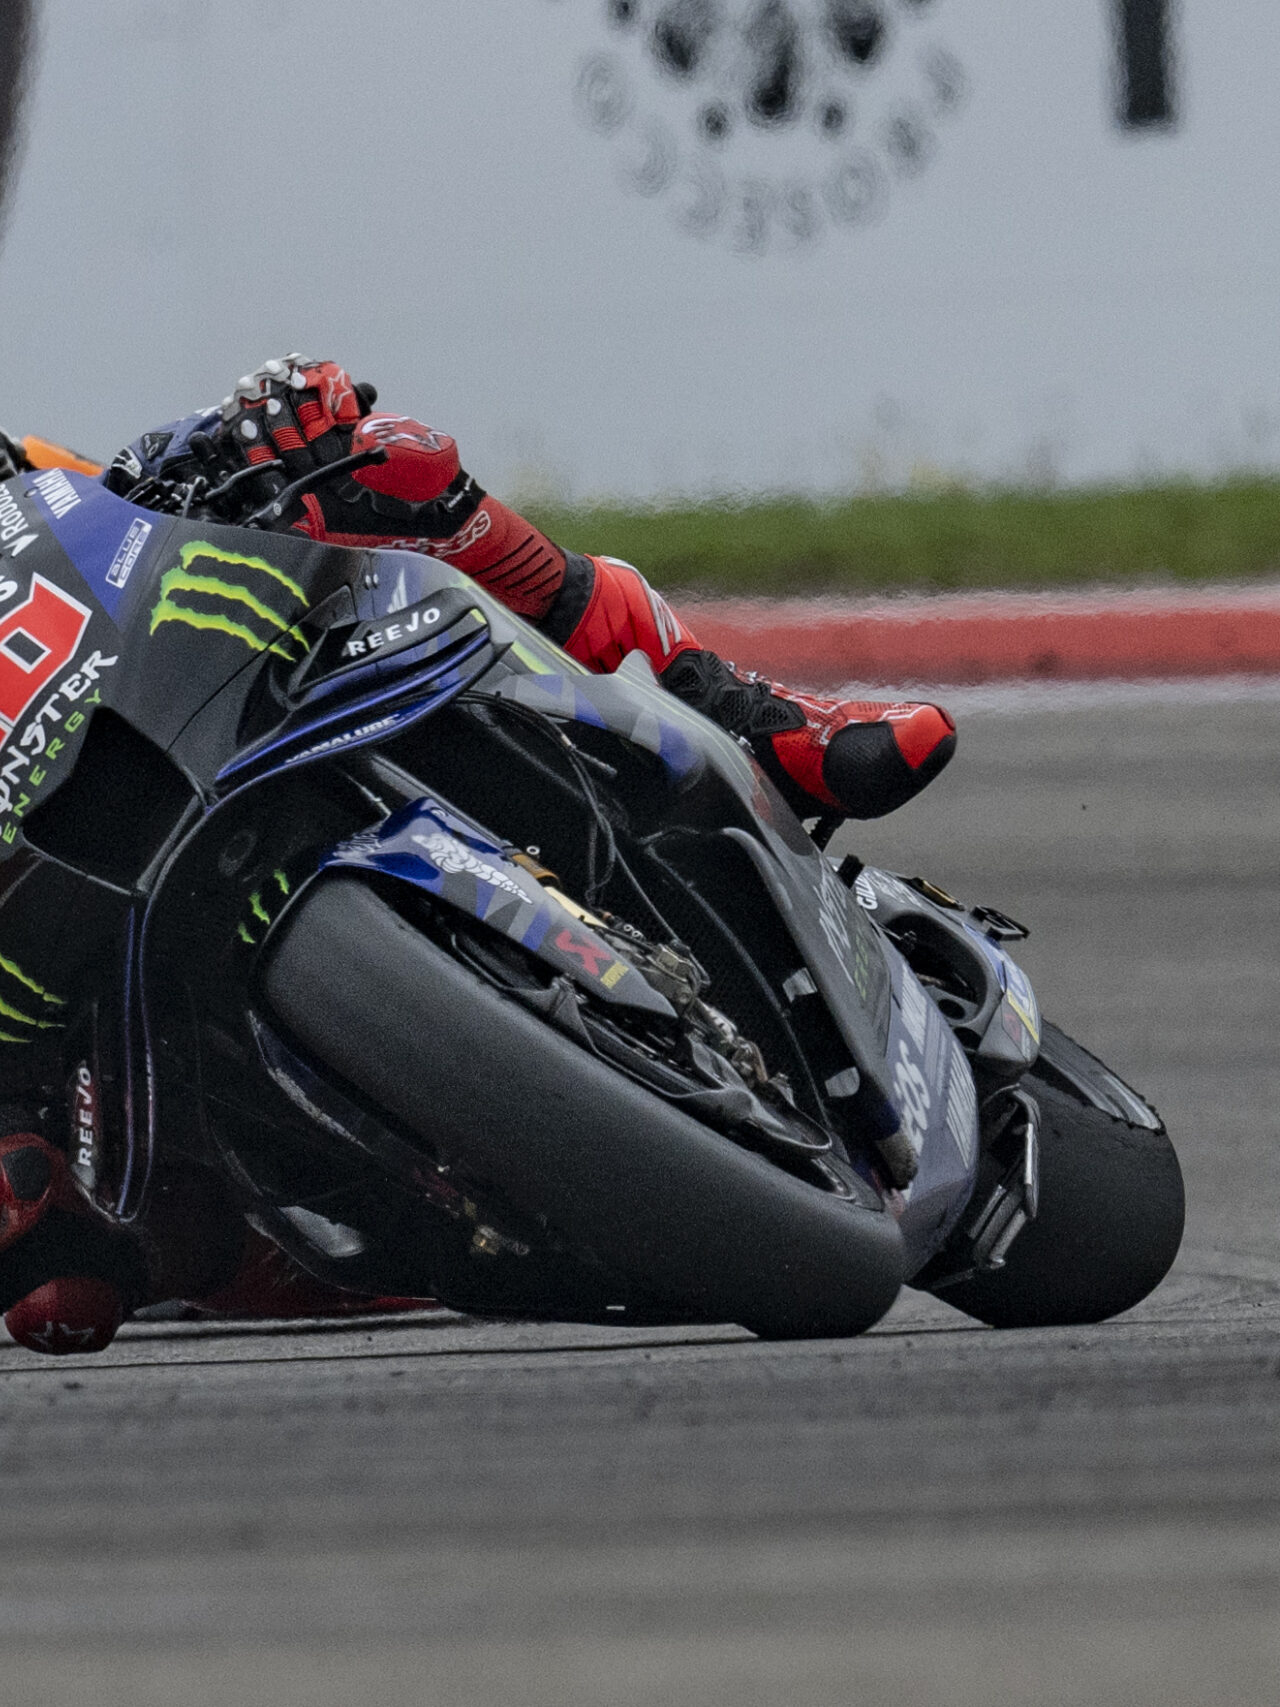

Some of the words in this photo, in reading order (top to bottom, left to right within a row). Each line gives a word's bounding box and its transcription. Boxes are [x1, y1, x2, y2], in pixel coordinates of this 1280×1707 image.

[32, 467, 82, 520] YAMAHA
[345, 607, 441, 657] REEVO
[2, 687, 102, 845] ENERGY
[77, 1065, 92, 1167] REEVO
